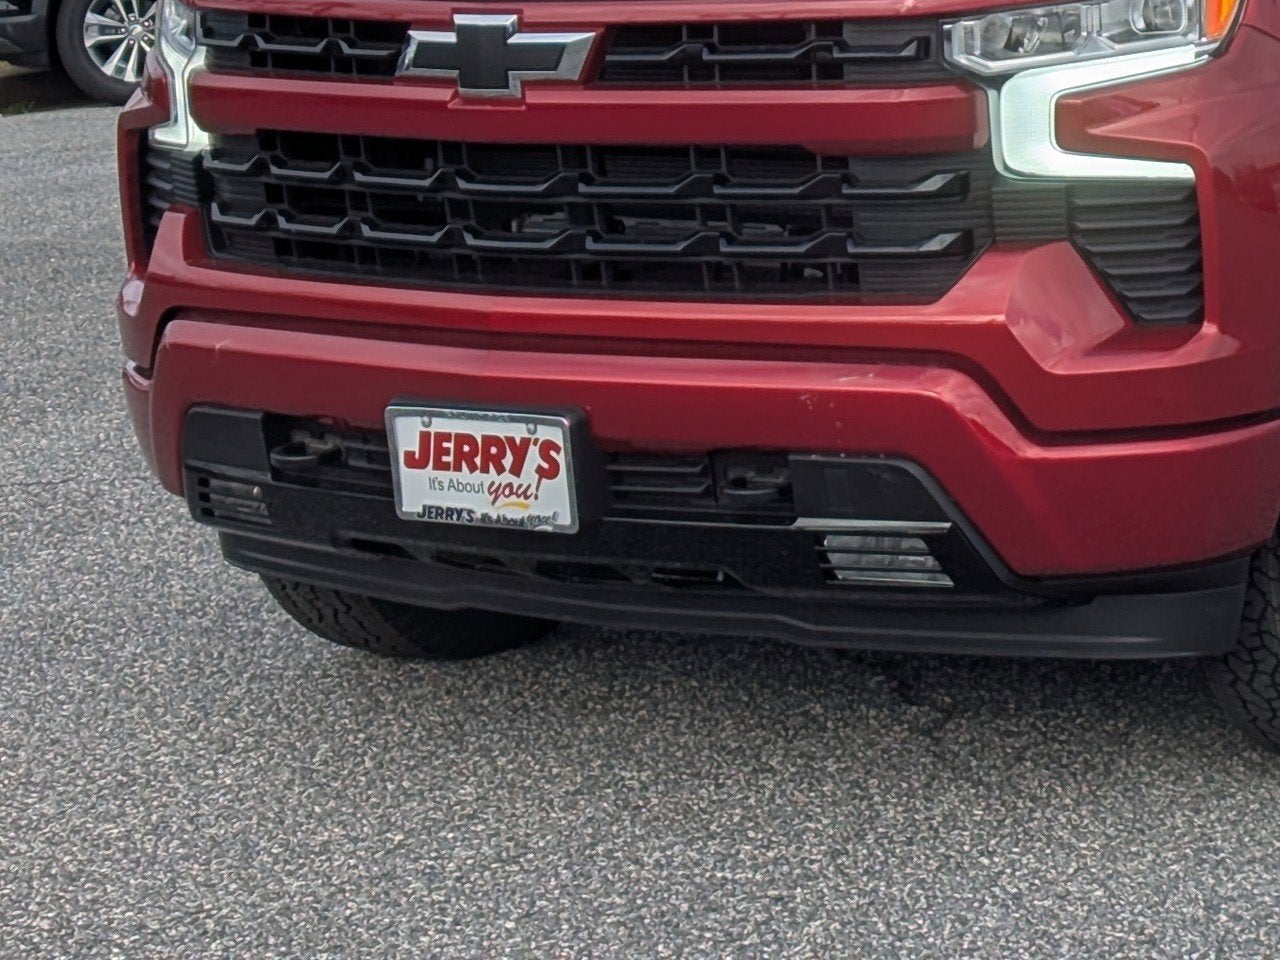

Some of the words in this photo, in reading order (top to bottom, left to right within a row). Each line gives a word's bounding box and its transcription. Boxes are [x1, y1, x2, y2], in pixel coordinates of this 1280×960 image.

[403, 430, 562, 481] JERRY'S
[428, 476, 444, 491] It's
[447, 477, 485, 495] About
[487, 477, 543, 506] you!
[416, 504, 475, 523] JERRY'S
